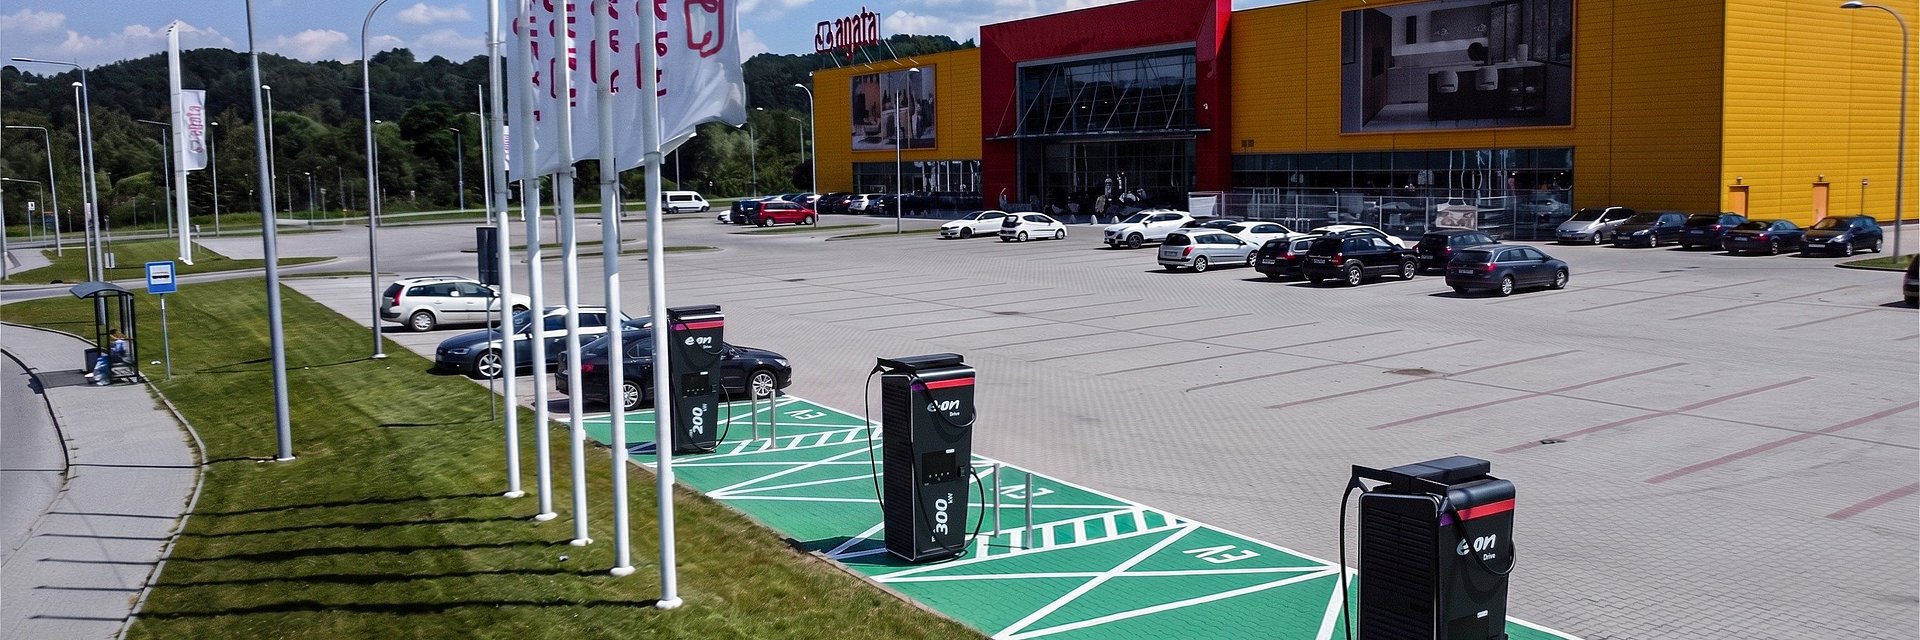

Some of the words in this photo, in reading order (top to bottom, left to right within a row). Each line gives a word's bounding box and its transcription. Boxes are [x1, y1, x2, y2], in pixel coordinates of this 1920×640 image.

[836, 6, 877, 61] agata
[692, 407, 704, 435] 200
[935, 498, 948, 535] 300
[947, 493, 953, 504] kW
[1182, 545, 1261, 564] EV
[1483, 553, 1496, 561] Drive
